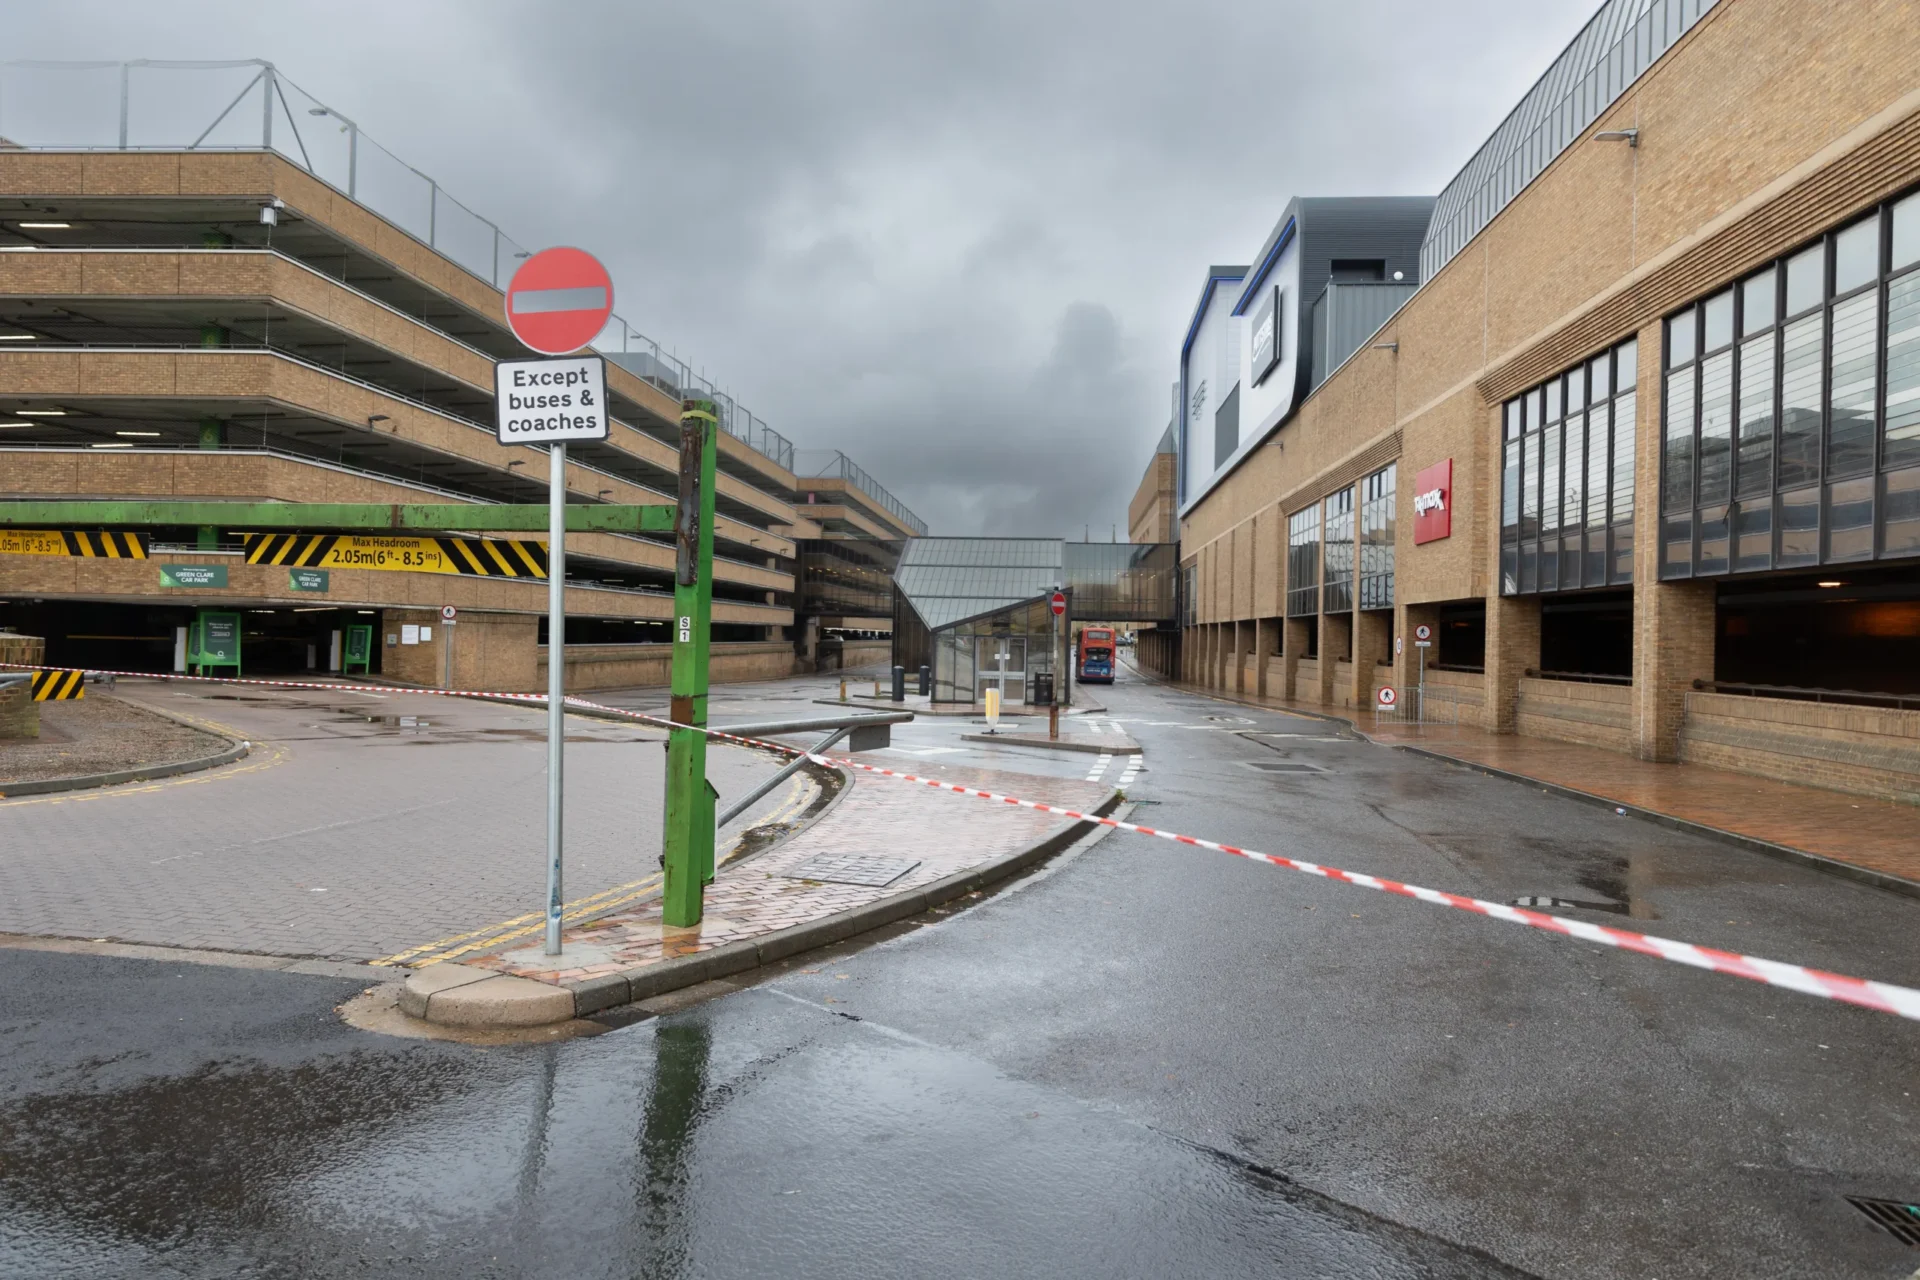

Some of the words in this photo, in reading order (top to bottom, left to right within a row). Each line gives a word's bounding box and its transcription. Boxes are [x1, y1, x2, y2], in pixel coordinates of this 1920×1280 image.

[513, 366, 589, 388] Except
[509, 393, 572, 410] buses
[580, 389, 595, 407] &
[508, 412, 597, 433] coaches
[352, 537, 371, 548] Max
[373, 538, 420, 549] Headroom
[681, 617, 689, 628] S
[682, 631, 687, 641] 1
